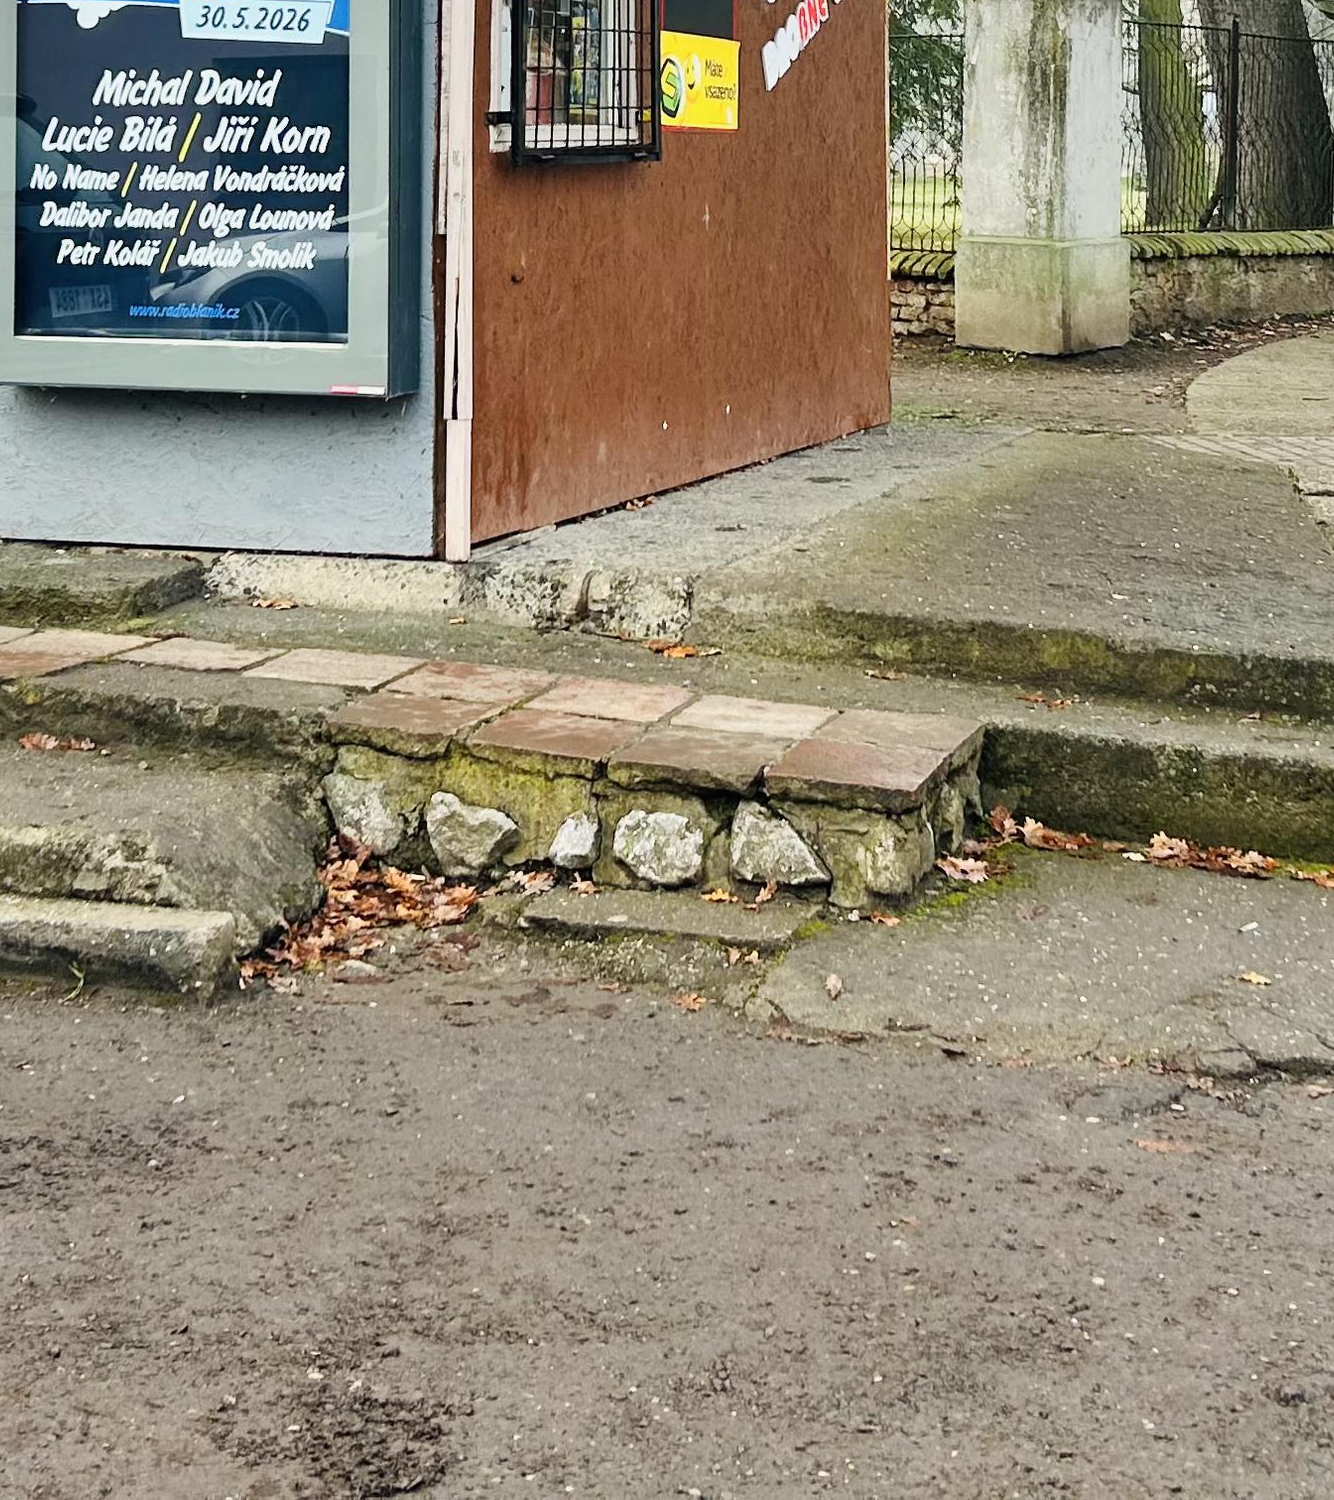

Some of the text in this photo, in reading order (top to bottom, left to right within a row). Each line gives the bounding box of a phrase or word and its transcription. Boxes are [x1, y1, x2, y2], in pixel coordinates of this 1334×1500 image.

[195, 5, 311, 33] 30.5.2026
[92, 68, 283, 108] Michal David
[42, 116, 114, 153] Lucie
[119, 115, 179, 154] Bílá
[203, 115, 254, 154] Jiří
[259, 116, 332, 155] Korn
[30, 164, 57, 191] No
[62, 166, 120, 192] Name
[139, 164, 209, 192] Helena
[213, 164, 346, 194] Vondráčková
[39, 201, 112, 229] Dalibor
[114, 203, 178, 229] Janda
[198, 202, 244, 238] Olga
[249, 203, 335, 231] Lounová
[56, 239, 101, 265] Petr
[103, 239, 162, 267] Kolář
[177, 242, 244, 268] Jakub
[247, 242, 317, 271] Smolík
[129, 302, 241, 321] www.radioblanik.cz
